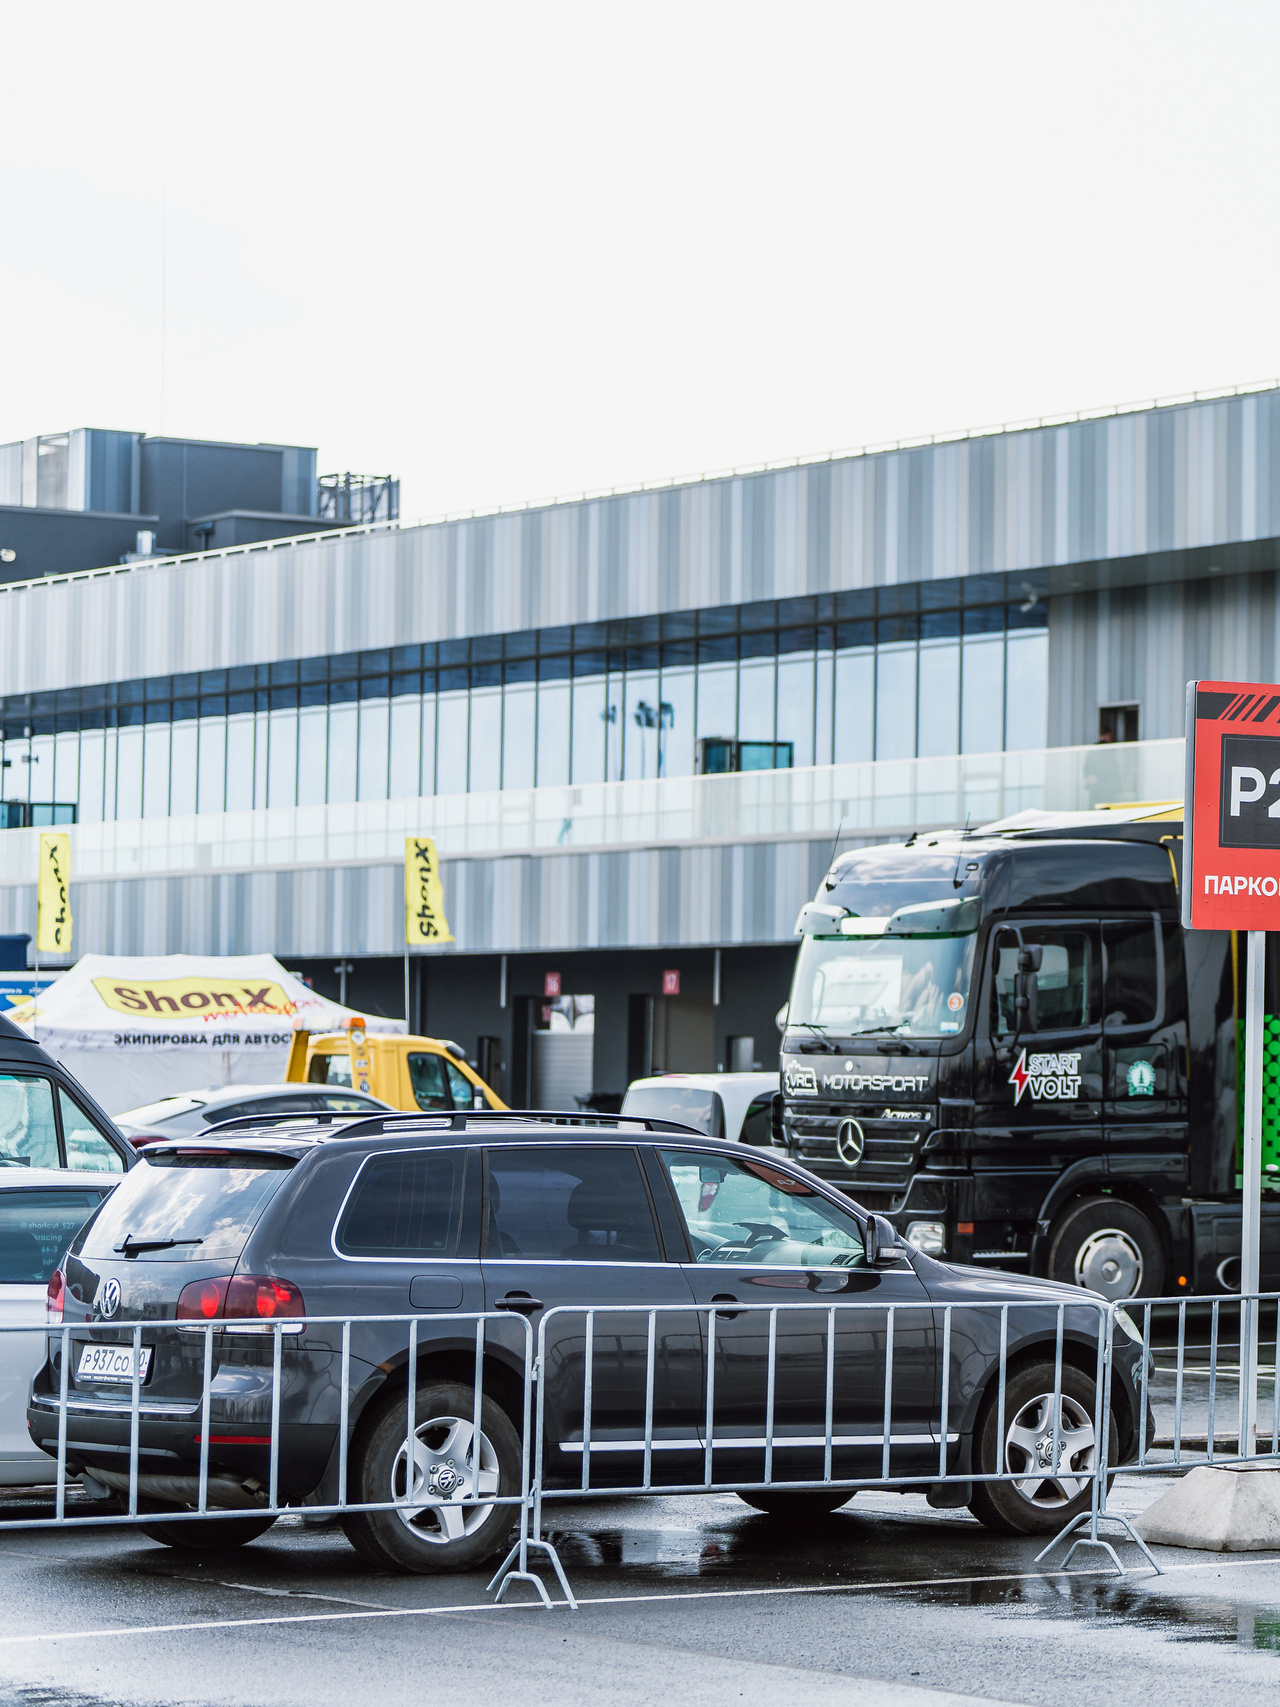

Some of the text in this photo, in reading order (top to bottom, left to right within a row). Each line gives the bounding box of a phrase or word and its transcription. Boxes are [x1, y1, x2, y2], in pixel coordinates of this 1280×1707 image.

[113, 987, 271, 1012] ShonX
[113, 1033, 293, 1046] ЭКИПИРОВКА ДЛЯ АВТОС
[1028, 1053, 1082, 1076] START
[789, 1073, 812, 1088] VRC
[822, 1074, 929, 1092] MOTORSPORT
[1029, 1076, 1082, 1100] VOLT
